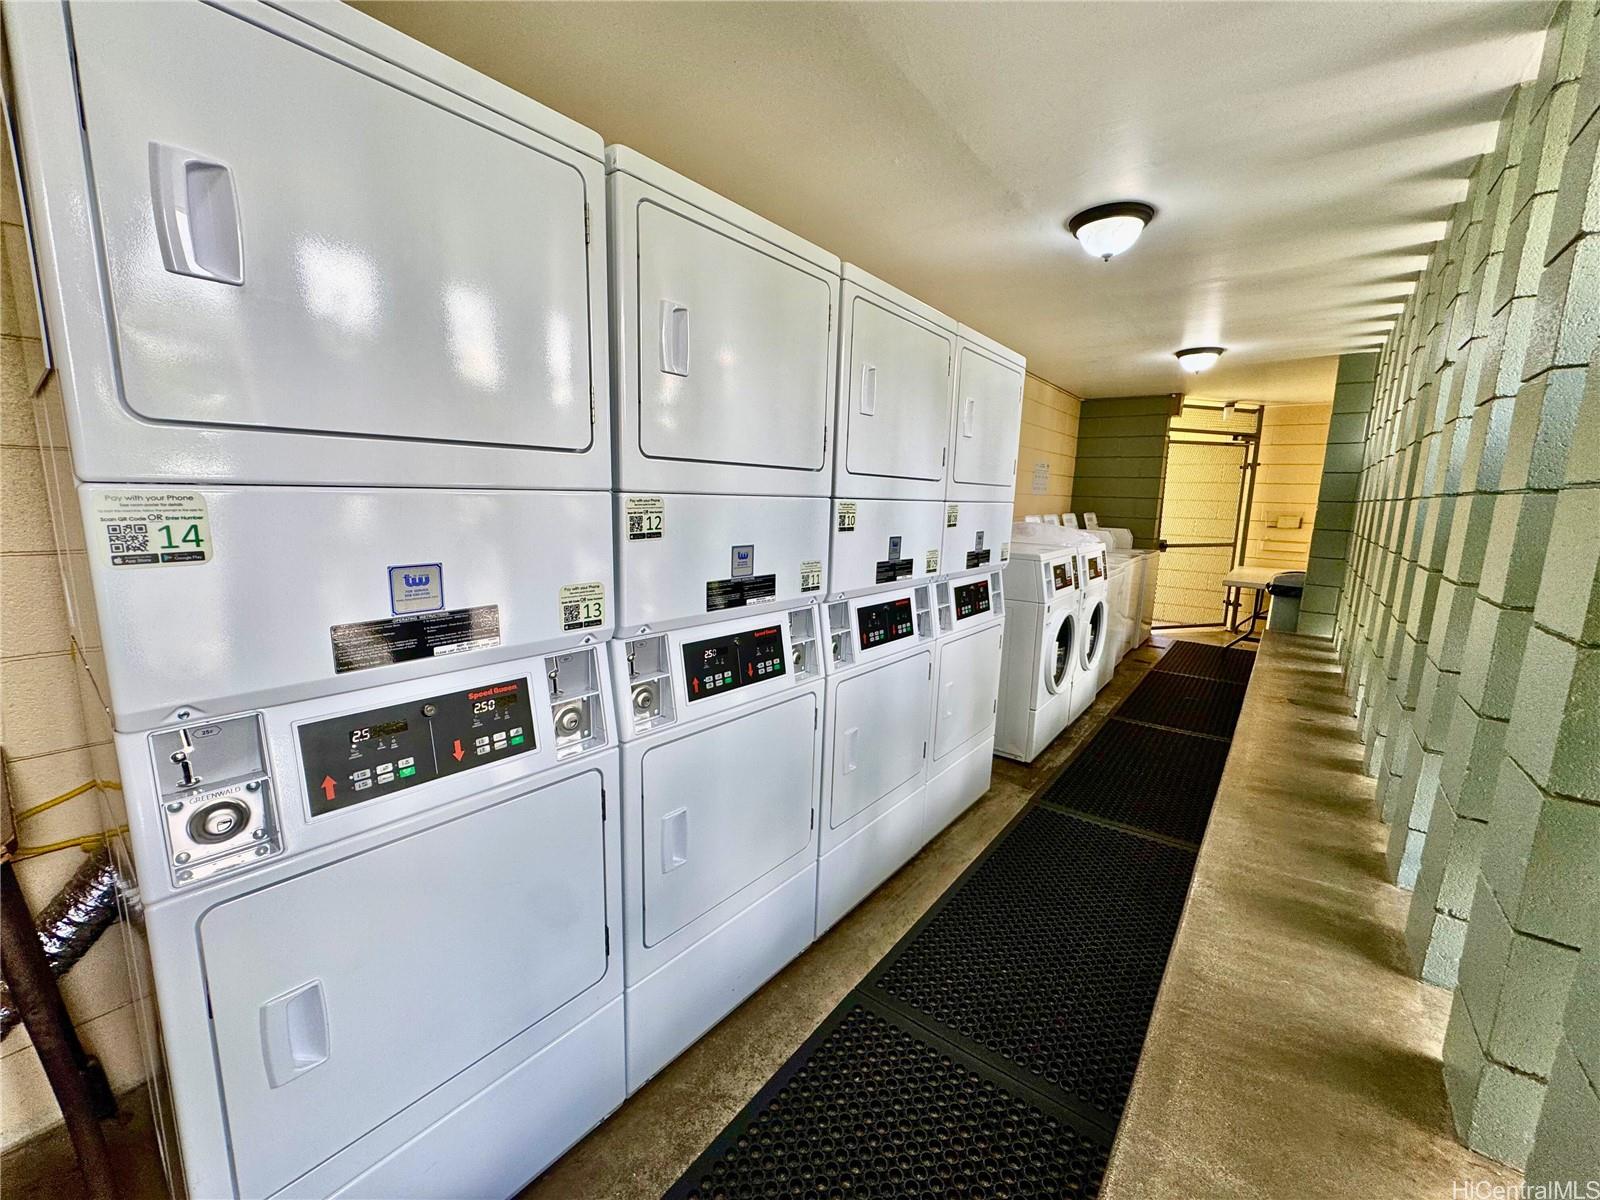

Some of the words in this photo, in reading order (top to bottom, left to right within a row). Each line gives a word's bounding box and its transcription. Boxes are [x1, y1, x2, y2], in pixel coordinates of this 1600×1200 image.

[646, 515, 662, 531] 12
[846, 515, 856, 526] 10
[158, 524, 204, 549] 14
[402, 574, 430, 588] tw
[811, 574, 820, 585] 11
[583, 602, 602, 619] 13
[468, 688, 493, 700] Speed
[494, 684, 518, 694] Queen
[352, 728, 370, 743] 2.5
[189, 786, 241, 804] GREENWALD
